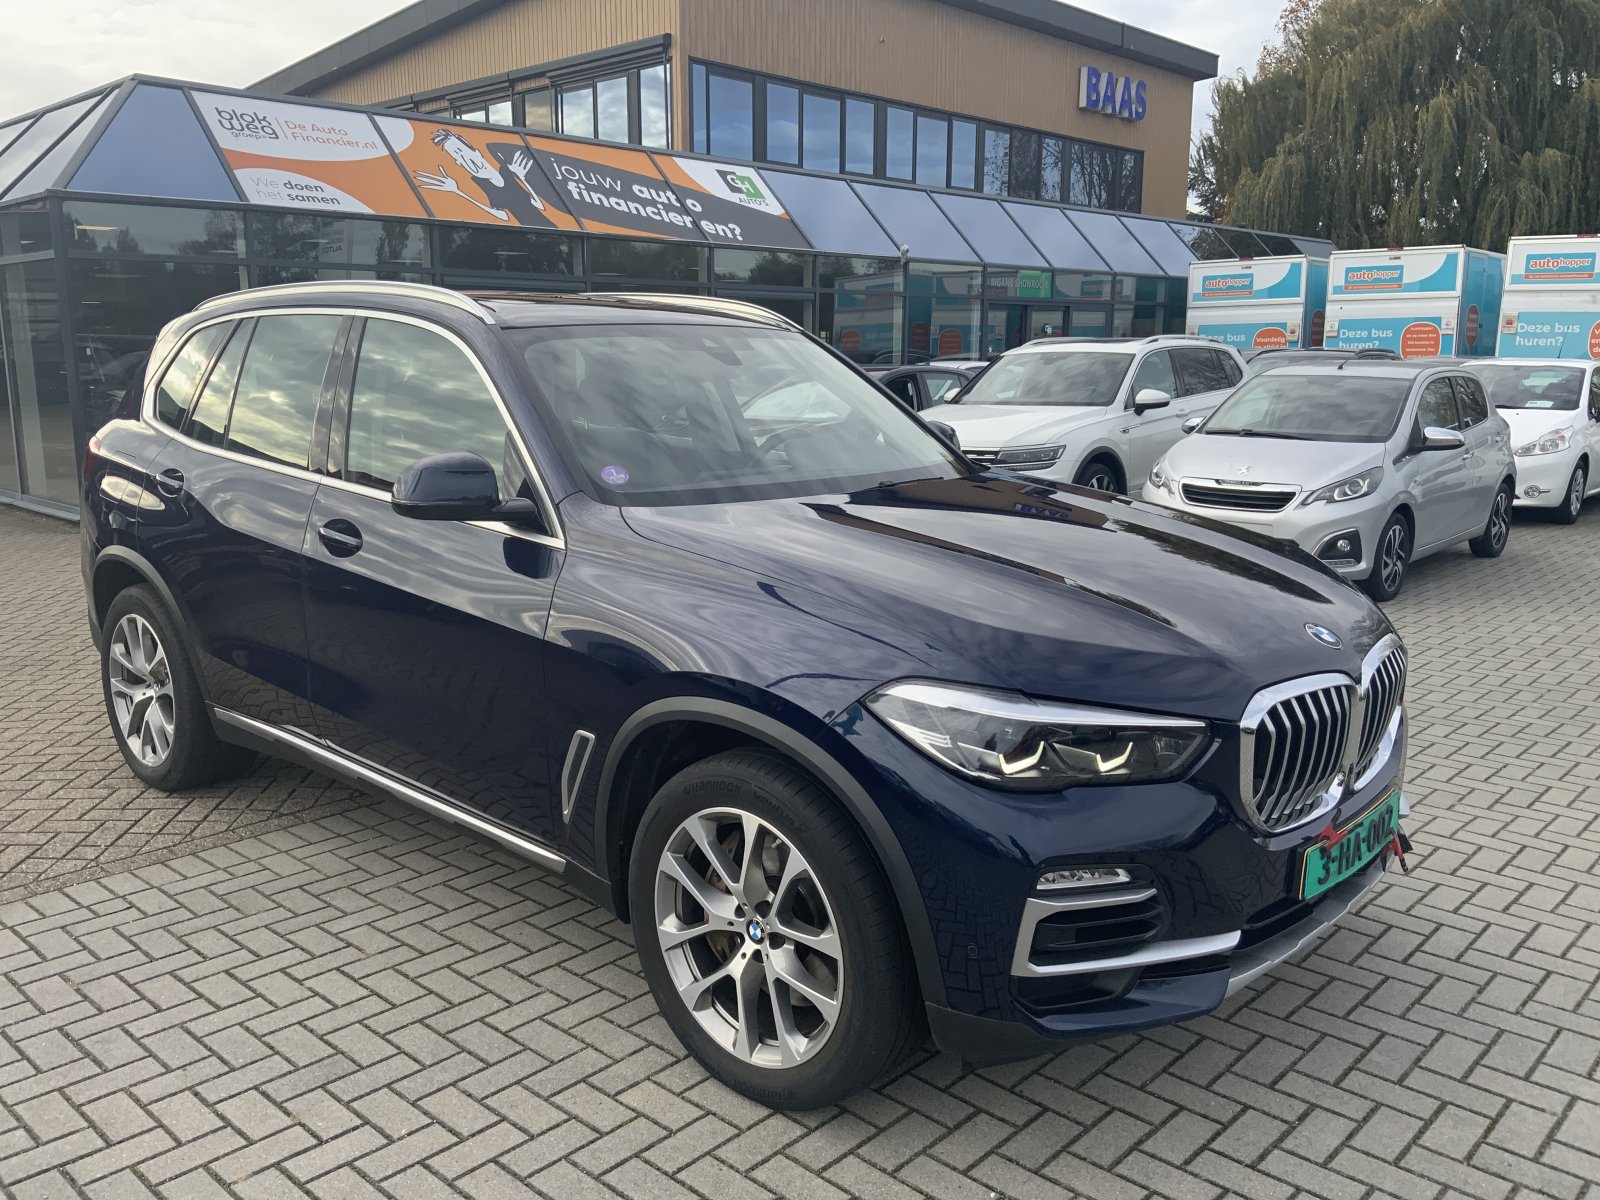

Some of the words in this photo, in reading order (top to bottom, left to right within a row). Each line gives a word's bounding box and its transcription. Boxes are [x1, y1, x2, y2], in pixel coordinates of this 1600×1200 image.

[1079, 66, 1147, 121] BAAS
[214, 106, 272, 126] blok
[217, 118, 279, 139] weg
[284, 120, 306, 131] De
[311, 123, 348, 136] Auto
[291, 131, 379, 151] Financier.nl
[550, 157, 621, 192] jouw
[248, 176, 280, 189] We
[283, 180, 325, 193] doen
[255, 188, 285, 201] het
[287, 193, 341, 206] samen
[738, 197, 769, 207] AUTO'S
[1528, 257, 1593, 271] autohopper
[1347, 269, 1401, 282] autohopper
[1204, 277, 1252, 290] autohopper
[1339, 329, 1369, 339] Deze
[1371, 328, 1393, 338] bus
[1517, 323, 1551, 333] Deze
[1554, 323, 1580, 333] bus
[1227, 333, 1246, 342] bus
[1256, 336, 1286, 344] Voordelig
[1515, 336, 1563, 346] huren?
[1338, 340, 1380, 350] huren?
[1318, 804, 1394, 885] 3-HA-002
